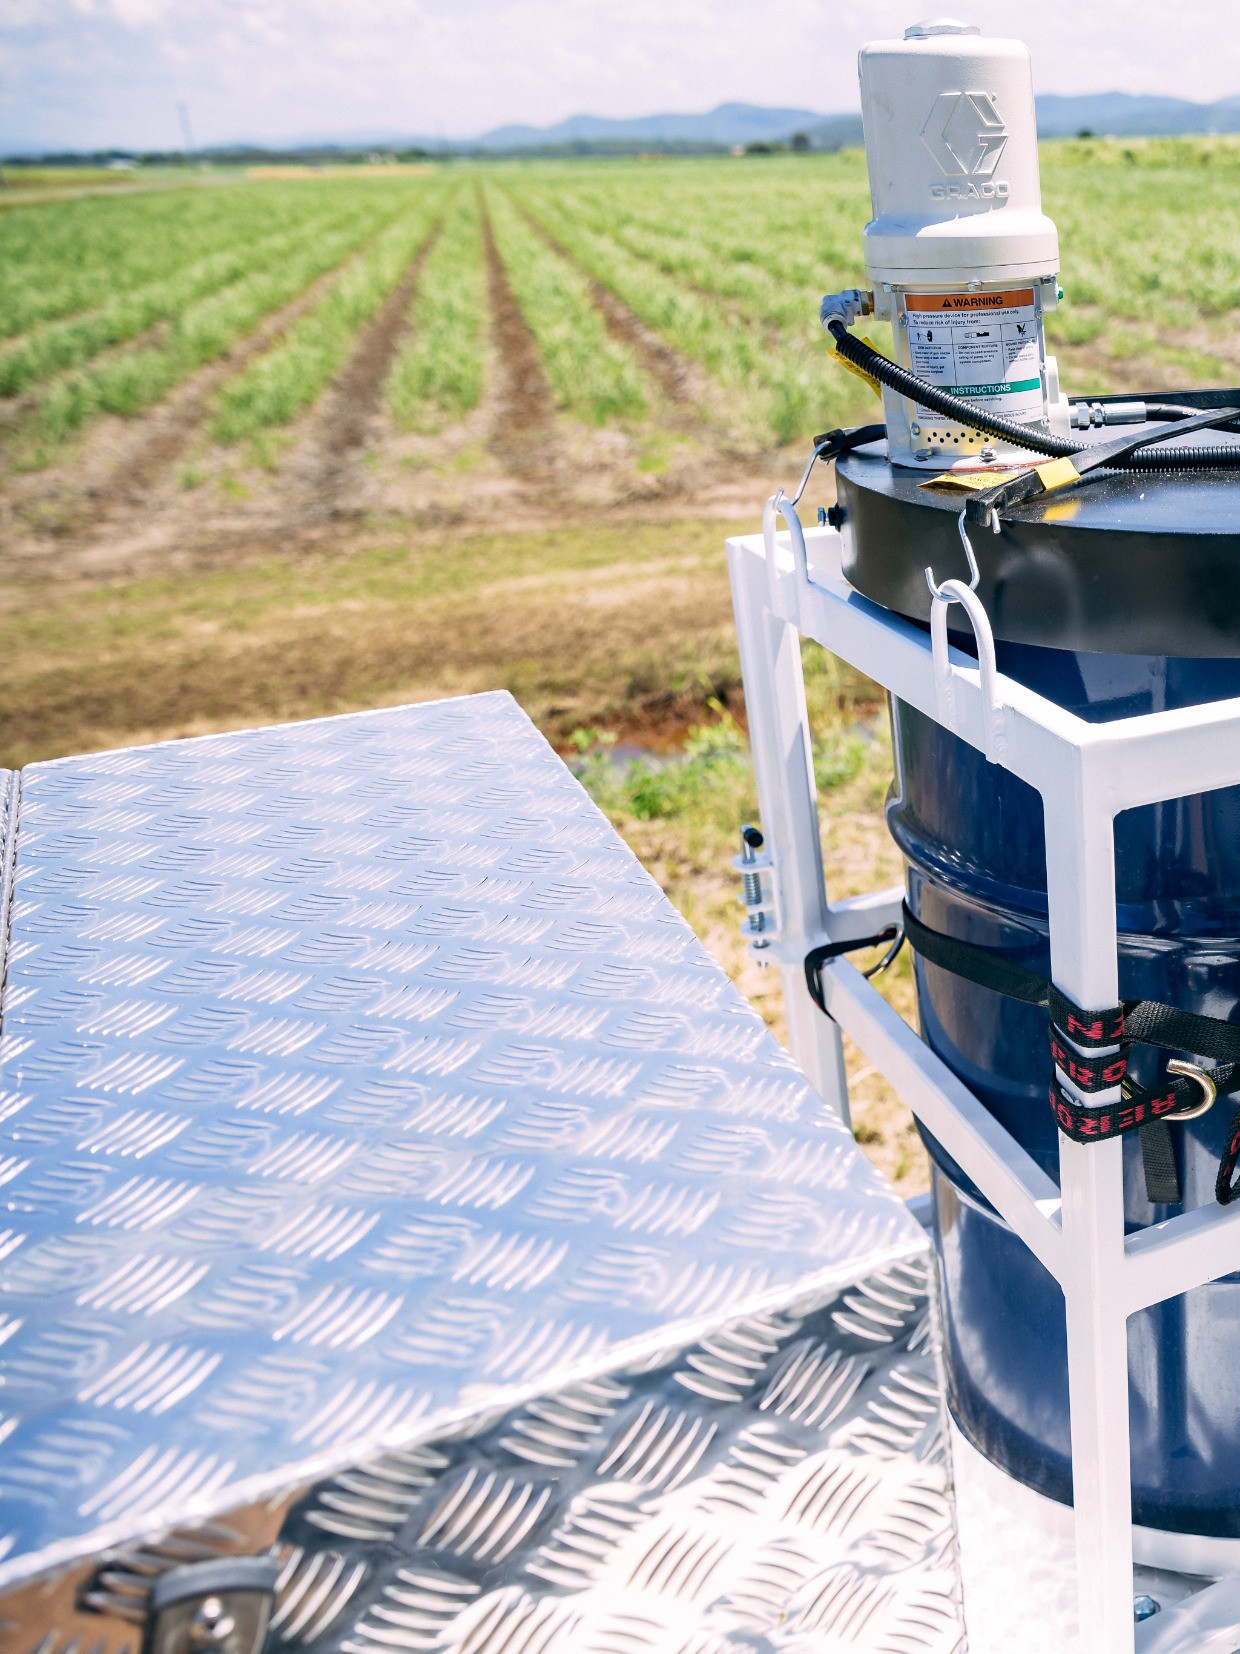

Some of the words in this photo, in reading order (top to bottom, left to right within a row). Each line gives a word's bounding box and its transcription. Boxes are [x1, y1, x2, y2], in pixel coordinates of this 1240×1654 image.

[928, 181, 1010, 200] GRACO
[953, 296, 1003, 307] WARNING
[951, 384, 1011, 395] INSTRUCTIONS
